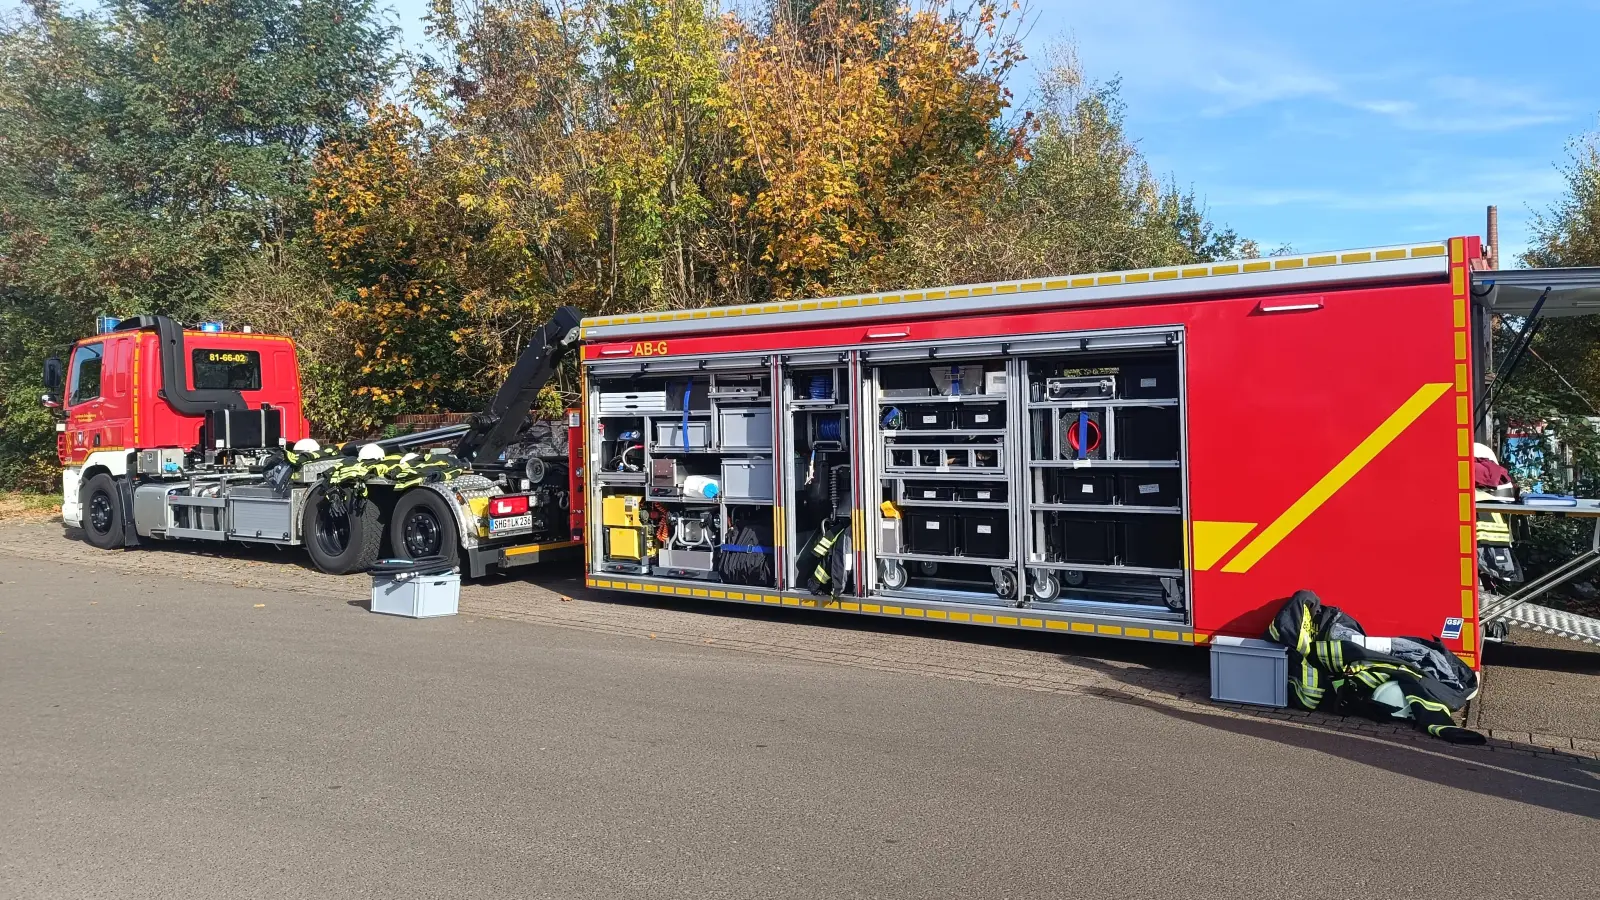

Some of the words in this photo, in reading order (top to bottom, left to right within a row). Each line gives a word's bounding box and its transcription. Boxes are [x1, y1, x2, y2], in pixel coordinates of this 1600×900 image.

[634, 341, 668, 356] AB-G
[209, 353, 246, 362] 81-66-02
[494, 519, 507, 529] SHG
